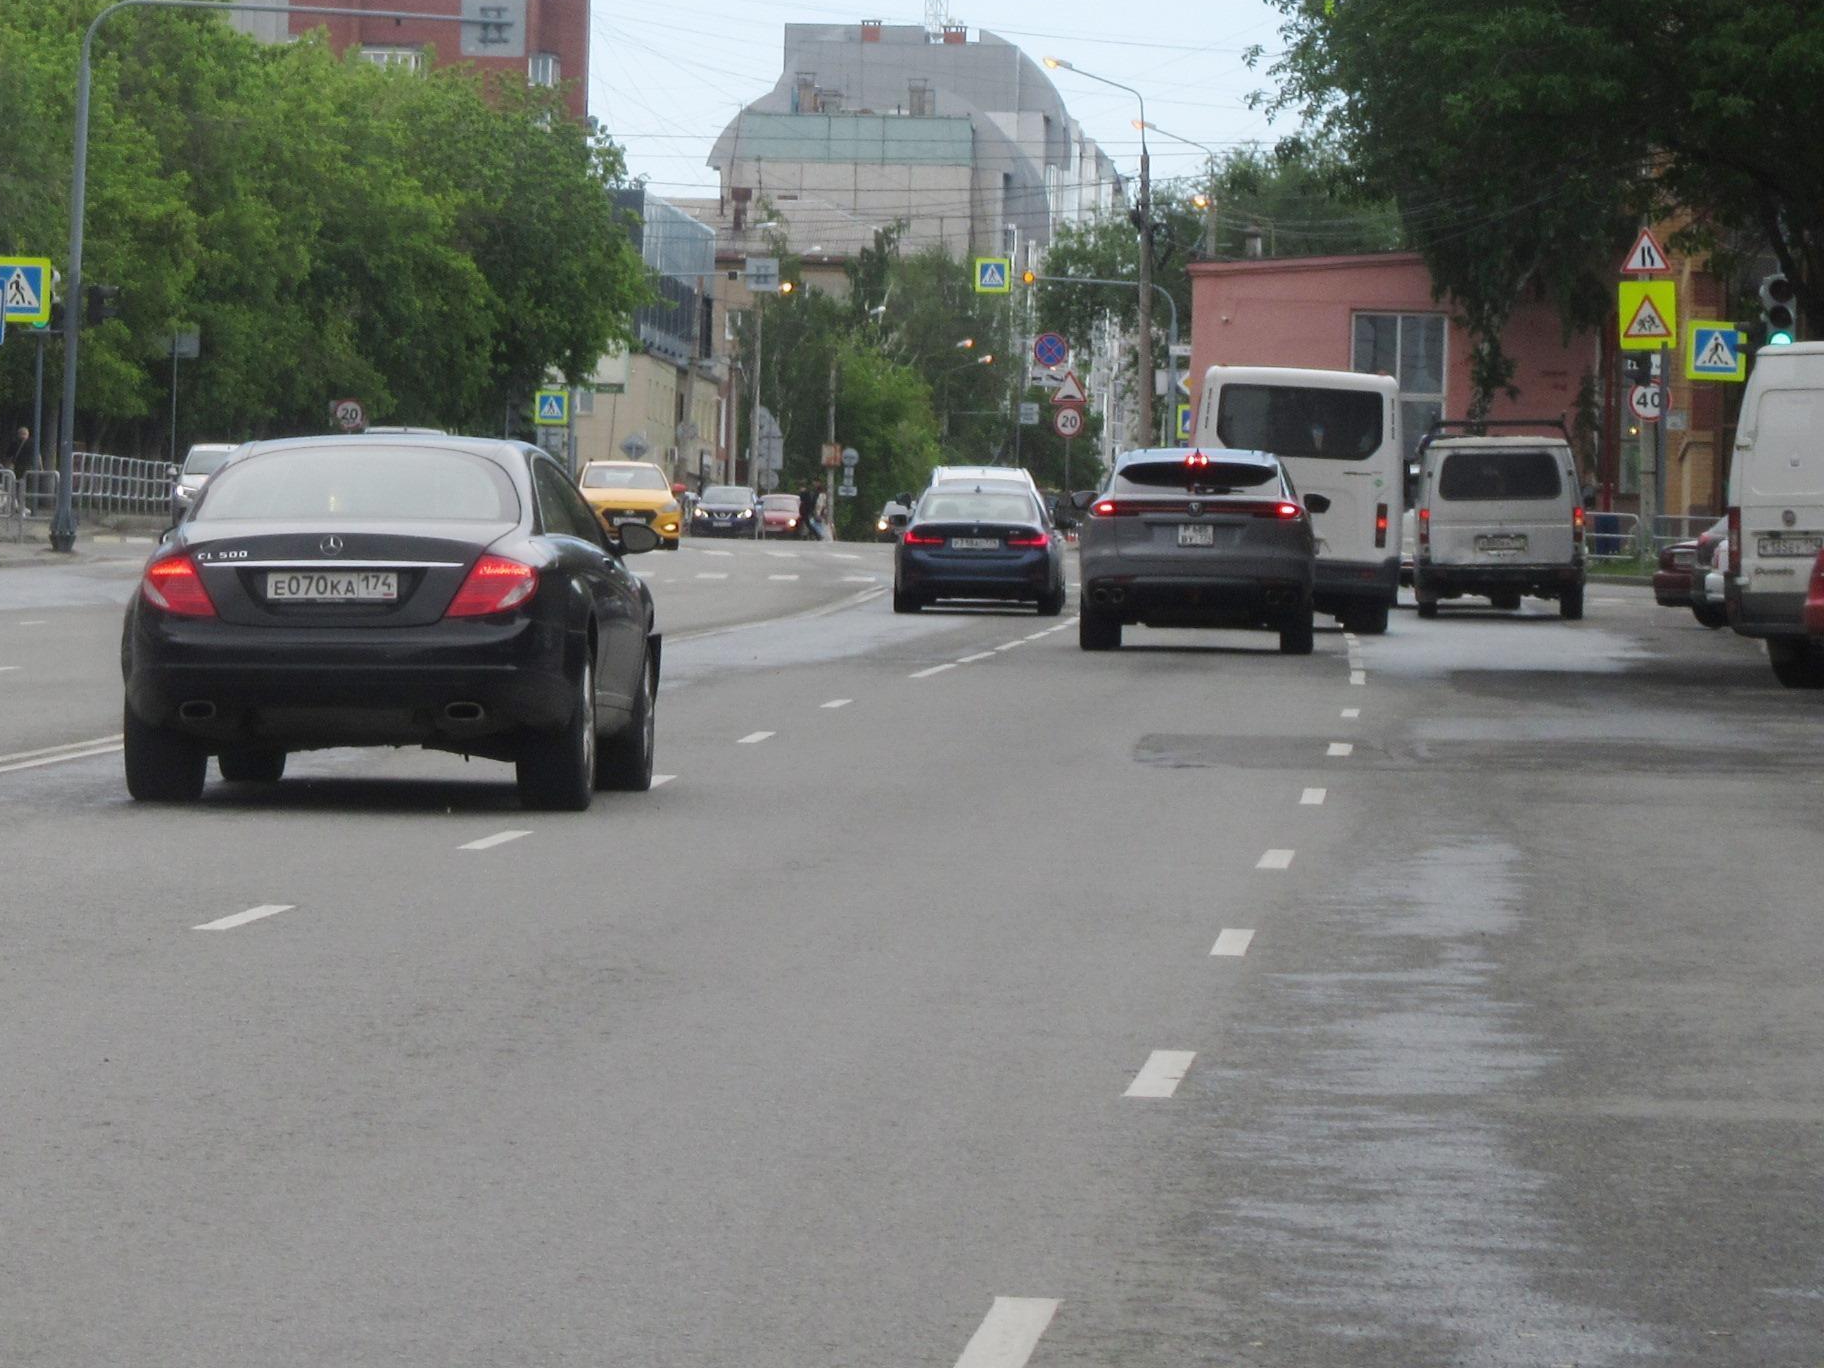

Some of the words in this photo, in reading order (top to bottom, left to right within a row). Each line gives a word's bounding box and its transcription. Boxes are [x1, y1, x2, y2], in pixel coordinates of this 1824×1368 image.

[1636, 391, 1662, 408] 40
[341, 407, 359, 421] 20
[1060, 414, 1078, 429] 20
[219, 550, 249, 559] 500
[273, 575, 357, 597] Е070КА
[360, 575, 392, 592] 174
